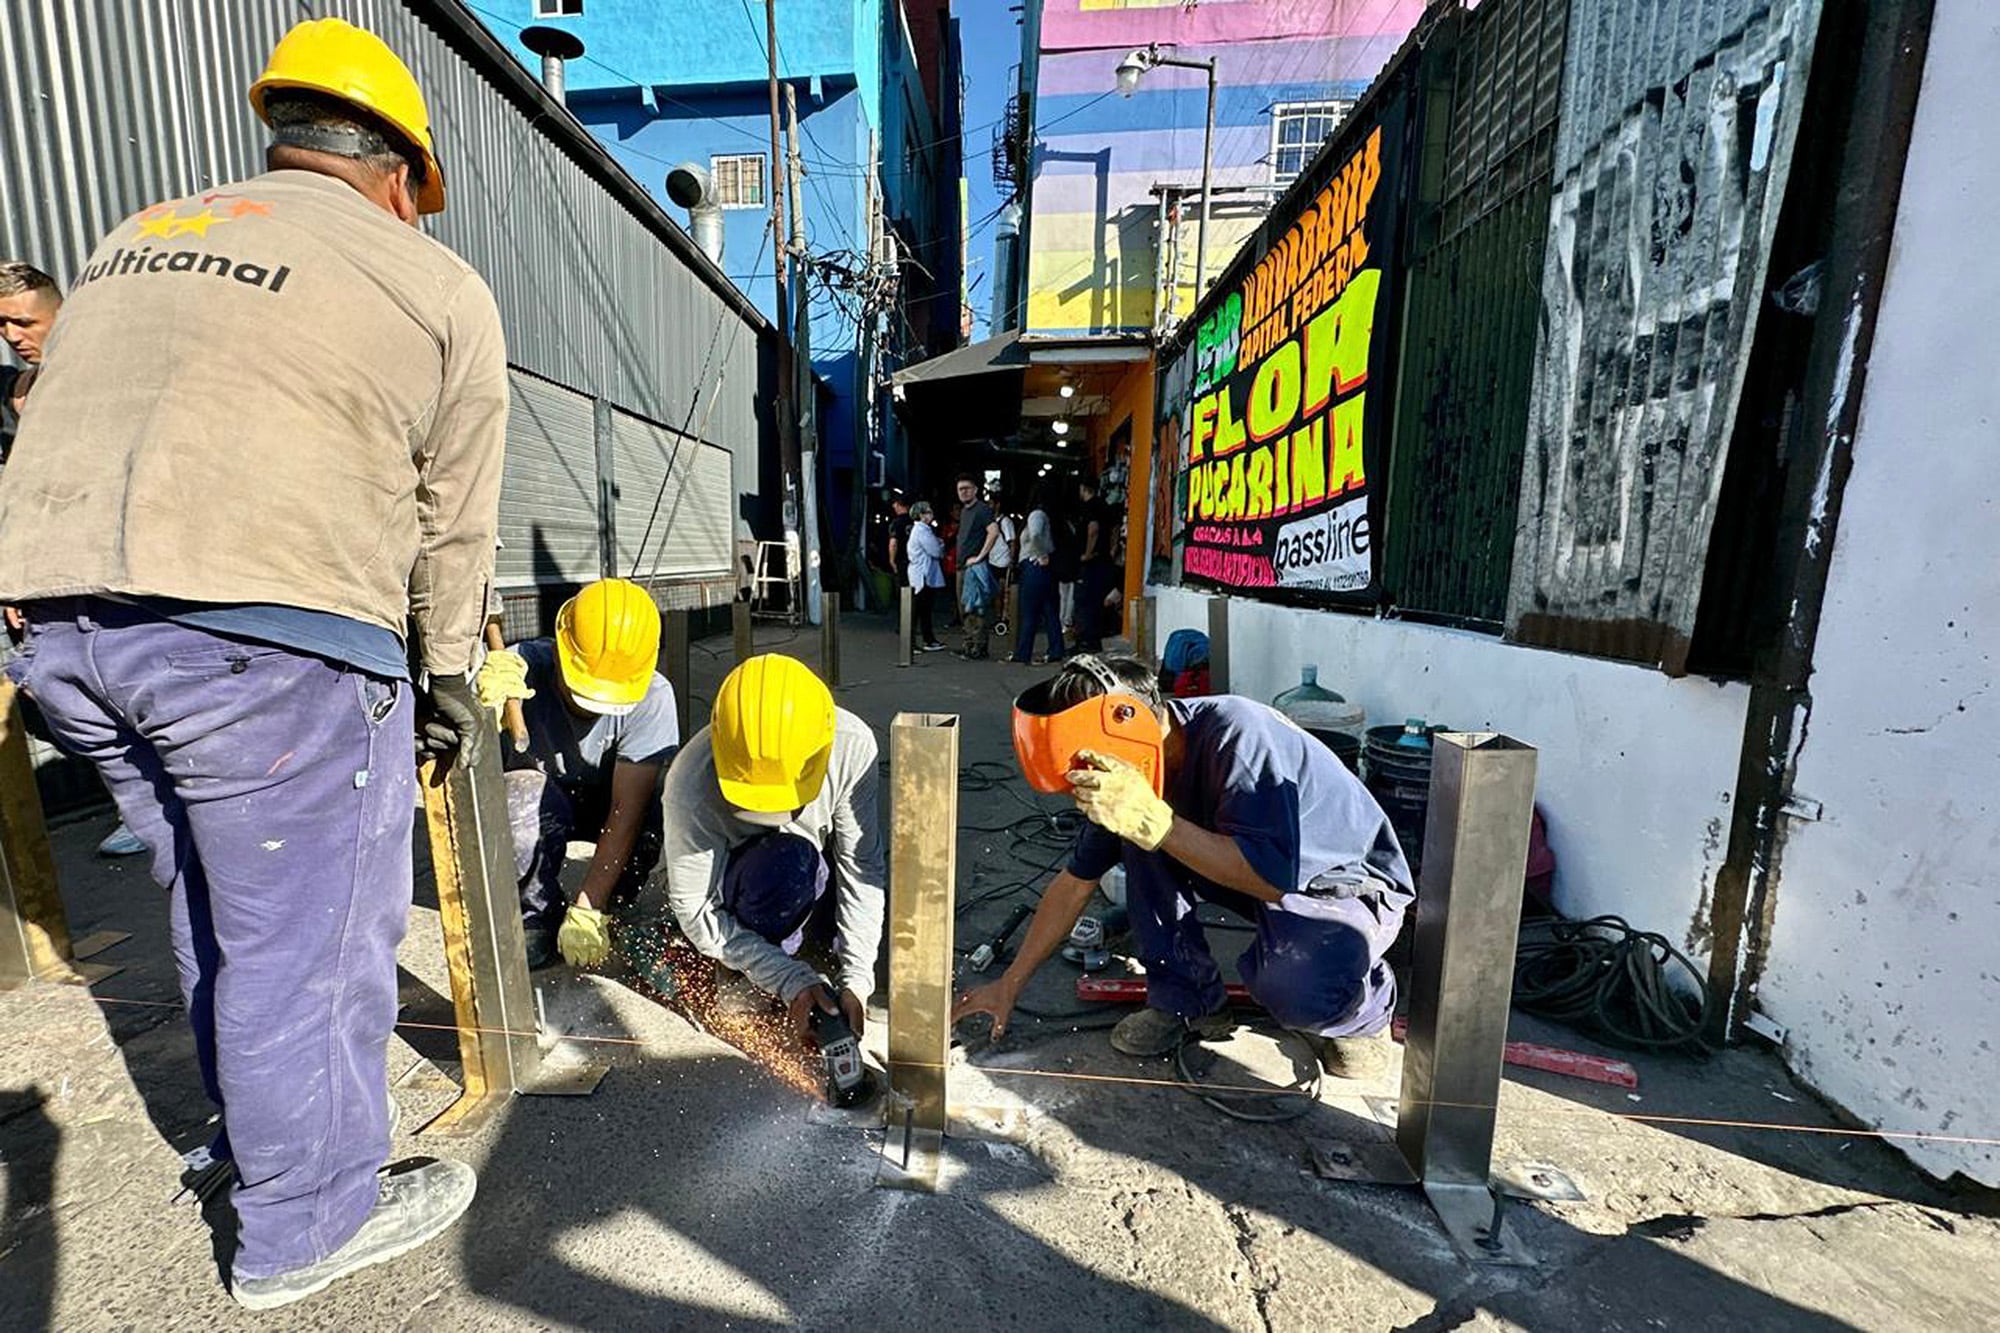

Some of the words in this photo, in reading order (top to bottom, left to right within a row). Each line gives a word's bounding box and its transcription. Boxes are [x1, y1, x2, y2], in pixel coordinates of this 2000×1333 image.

[1238, 304, 1290, 373] CAPITAL
[1188, 391, 1365, 522] PUCARINA
[1276, 510, 1370, 581] passline
